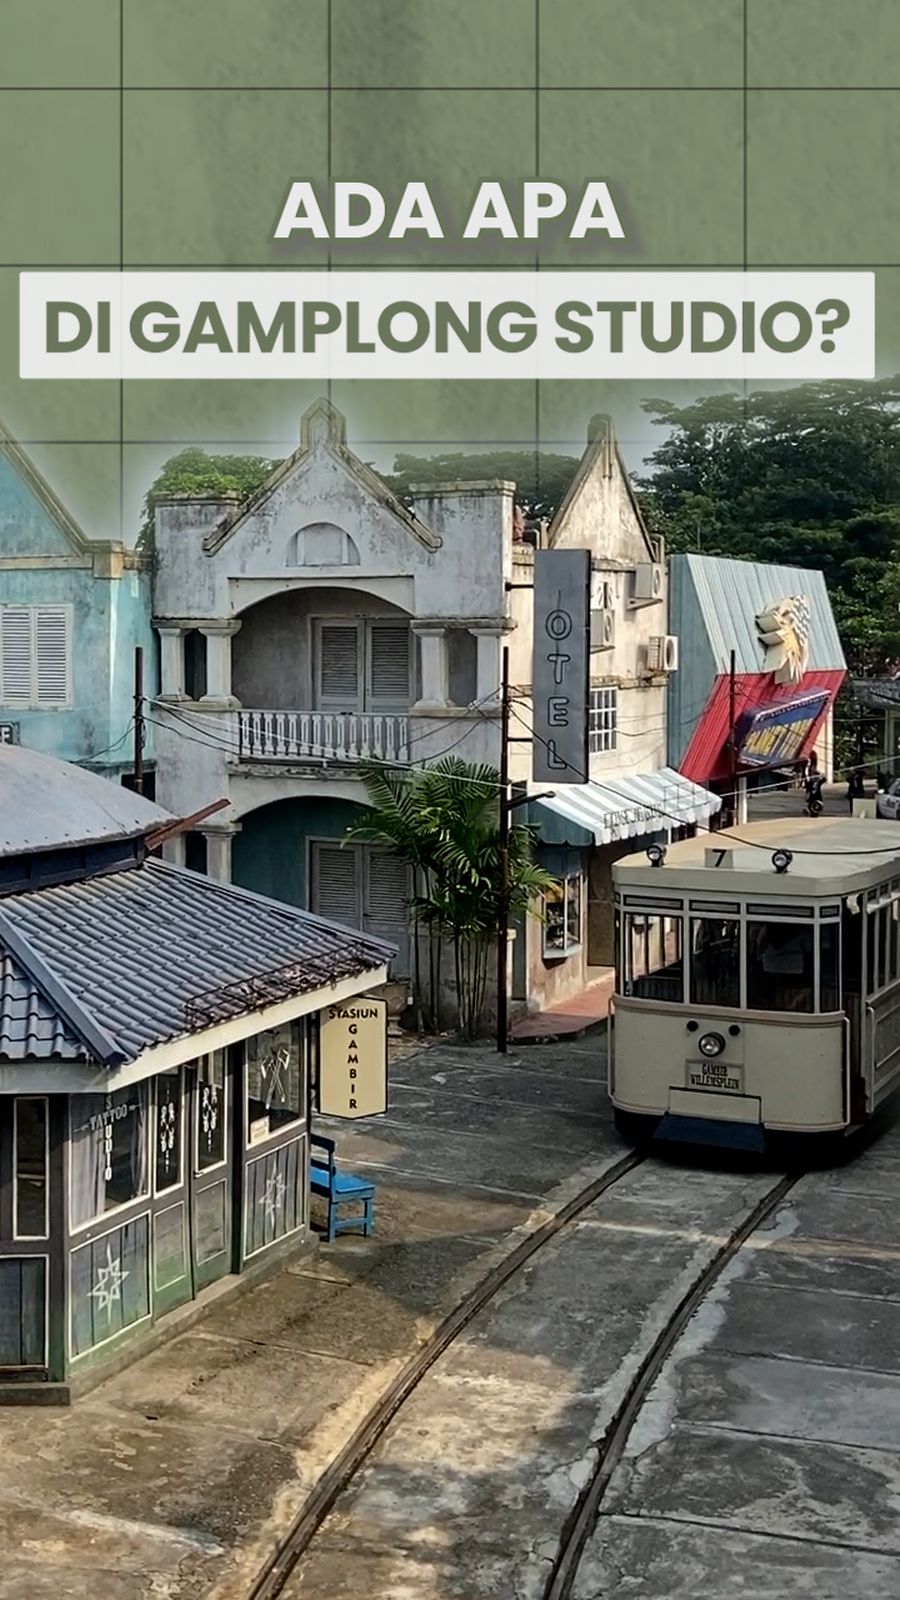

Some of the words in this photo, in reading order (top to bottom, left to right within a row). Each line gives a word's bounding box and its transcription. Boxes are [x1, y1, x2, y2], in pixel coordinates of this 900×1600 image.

[712, 848, 727, 868] 7
[328, 1008, 378, 1020] STASIUN
[347, 1024, 359, 1110] GAMBIR
[89, 1104, 128, 1131] TATTOO
